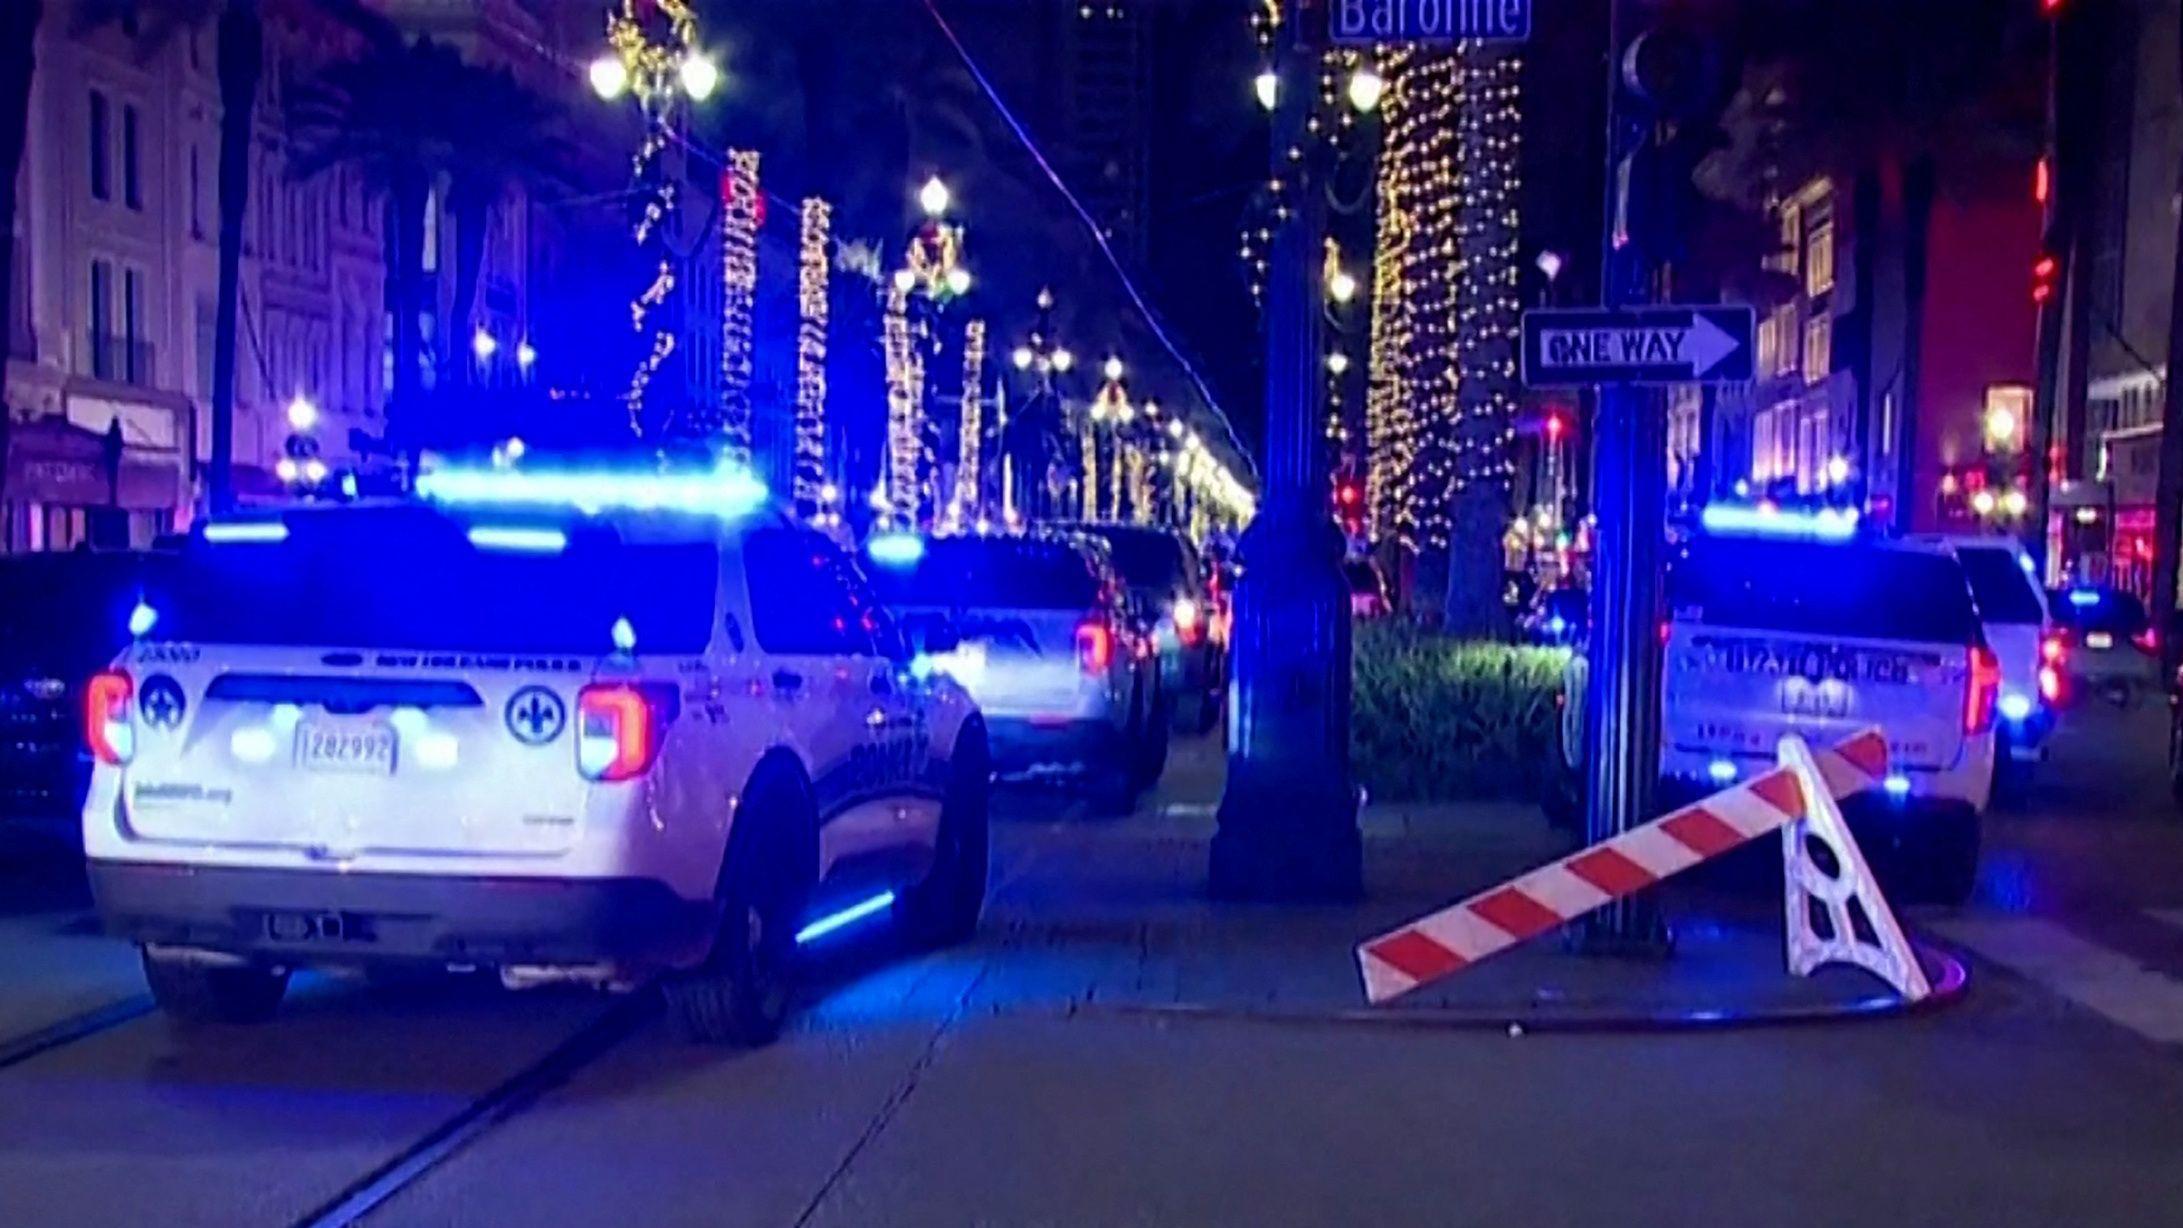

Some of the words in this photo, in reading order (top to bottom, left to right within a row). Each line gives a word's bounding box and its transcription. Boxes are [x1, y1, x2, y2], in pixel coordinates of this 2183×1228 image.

[1340, 0, 1518, 34] Baronne
[1550, 331, 1611, 362] ONE
[1619, 331, 1687, 362] WAY
